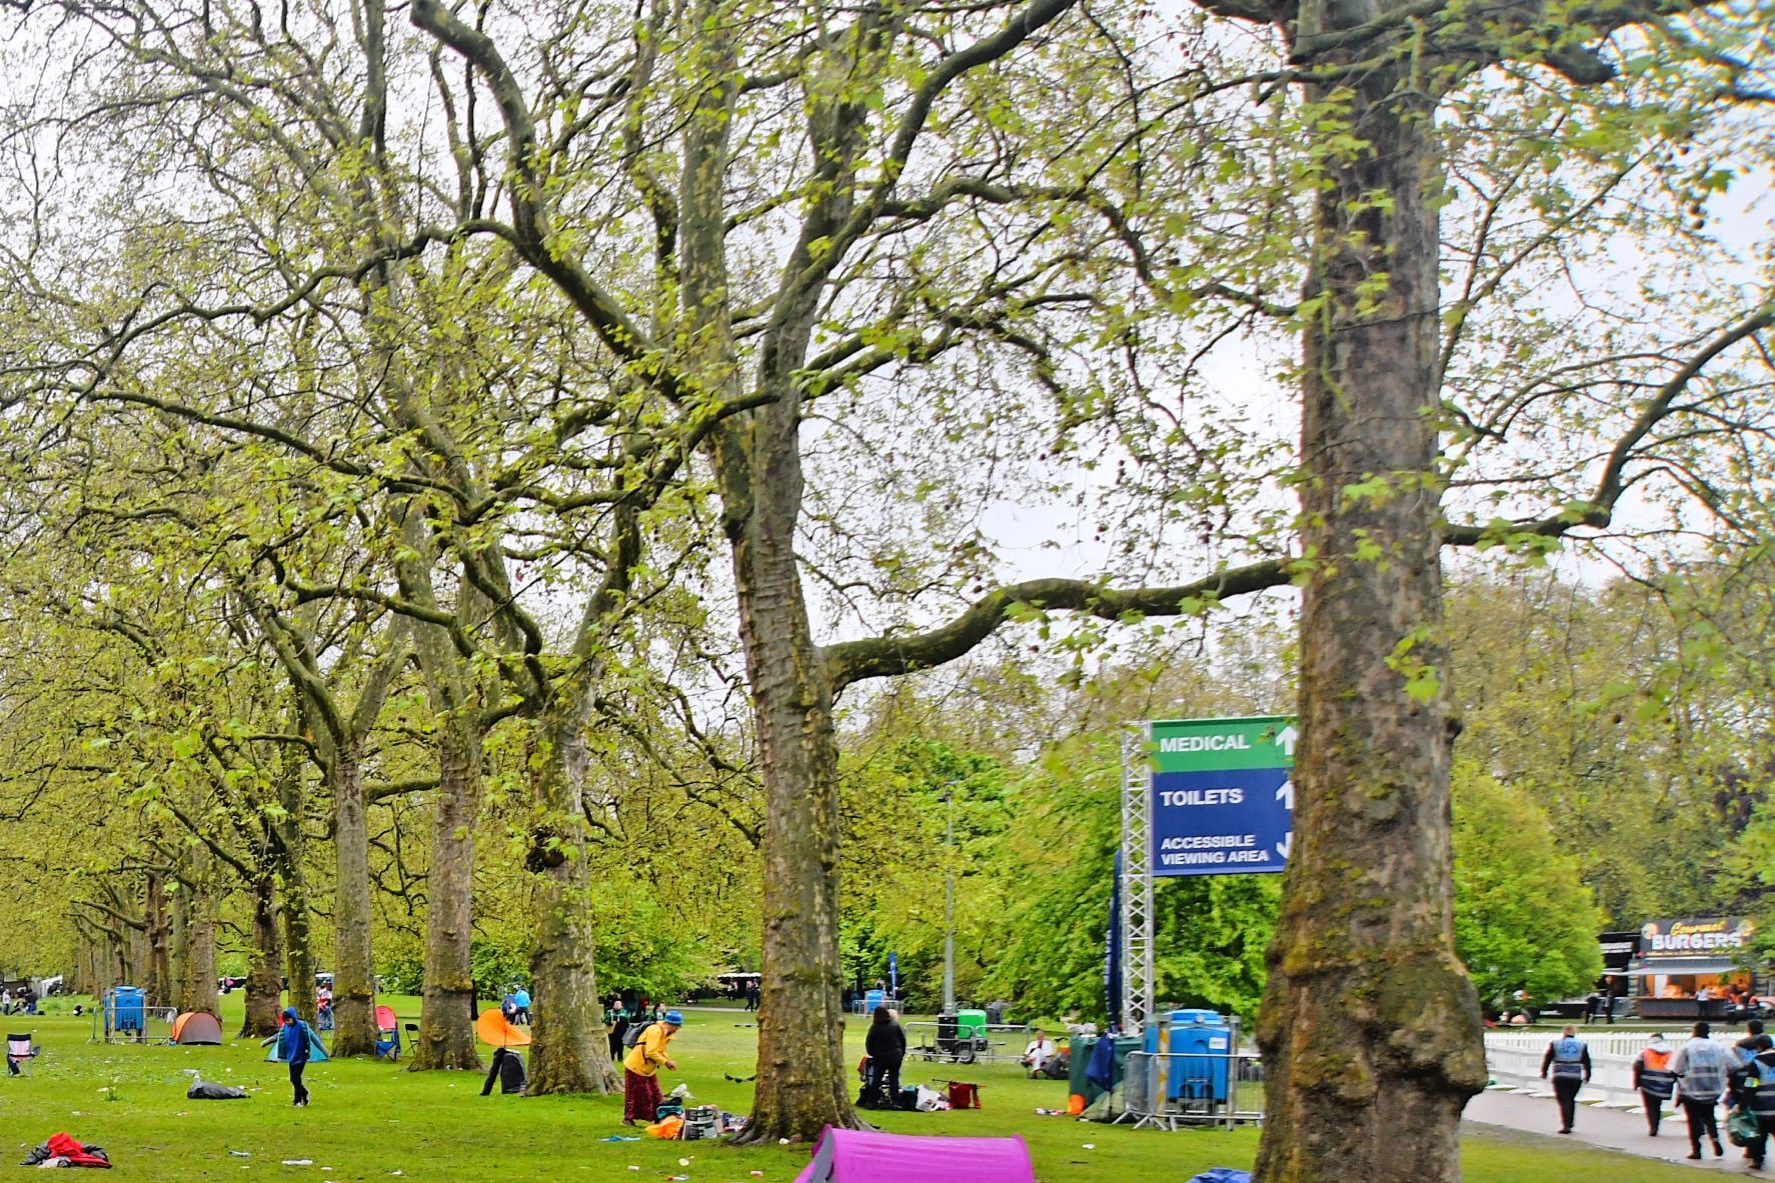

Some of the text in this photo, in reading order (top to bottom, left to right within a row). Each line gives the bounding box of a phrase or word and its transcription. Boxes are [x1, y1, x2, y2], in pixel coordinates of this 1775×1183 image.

[1160, 735, 1251, 753] MEDICAL
[1160, 788, 1244, 806] TOILETS
[1161, 835, 1256, 850] ACCESSIBLE
[1161, 850, 1270, 865] VIEWING AREA
[1651, 932, 1743, 950] BURGERS
